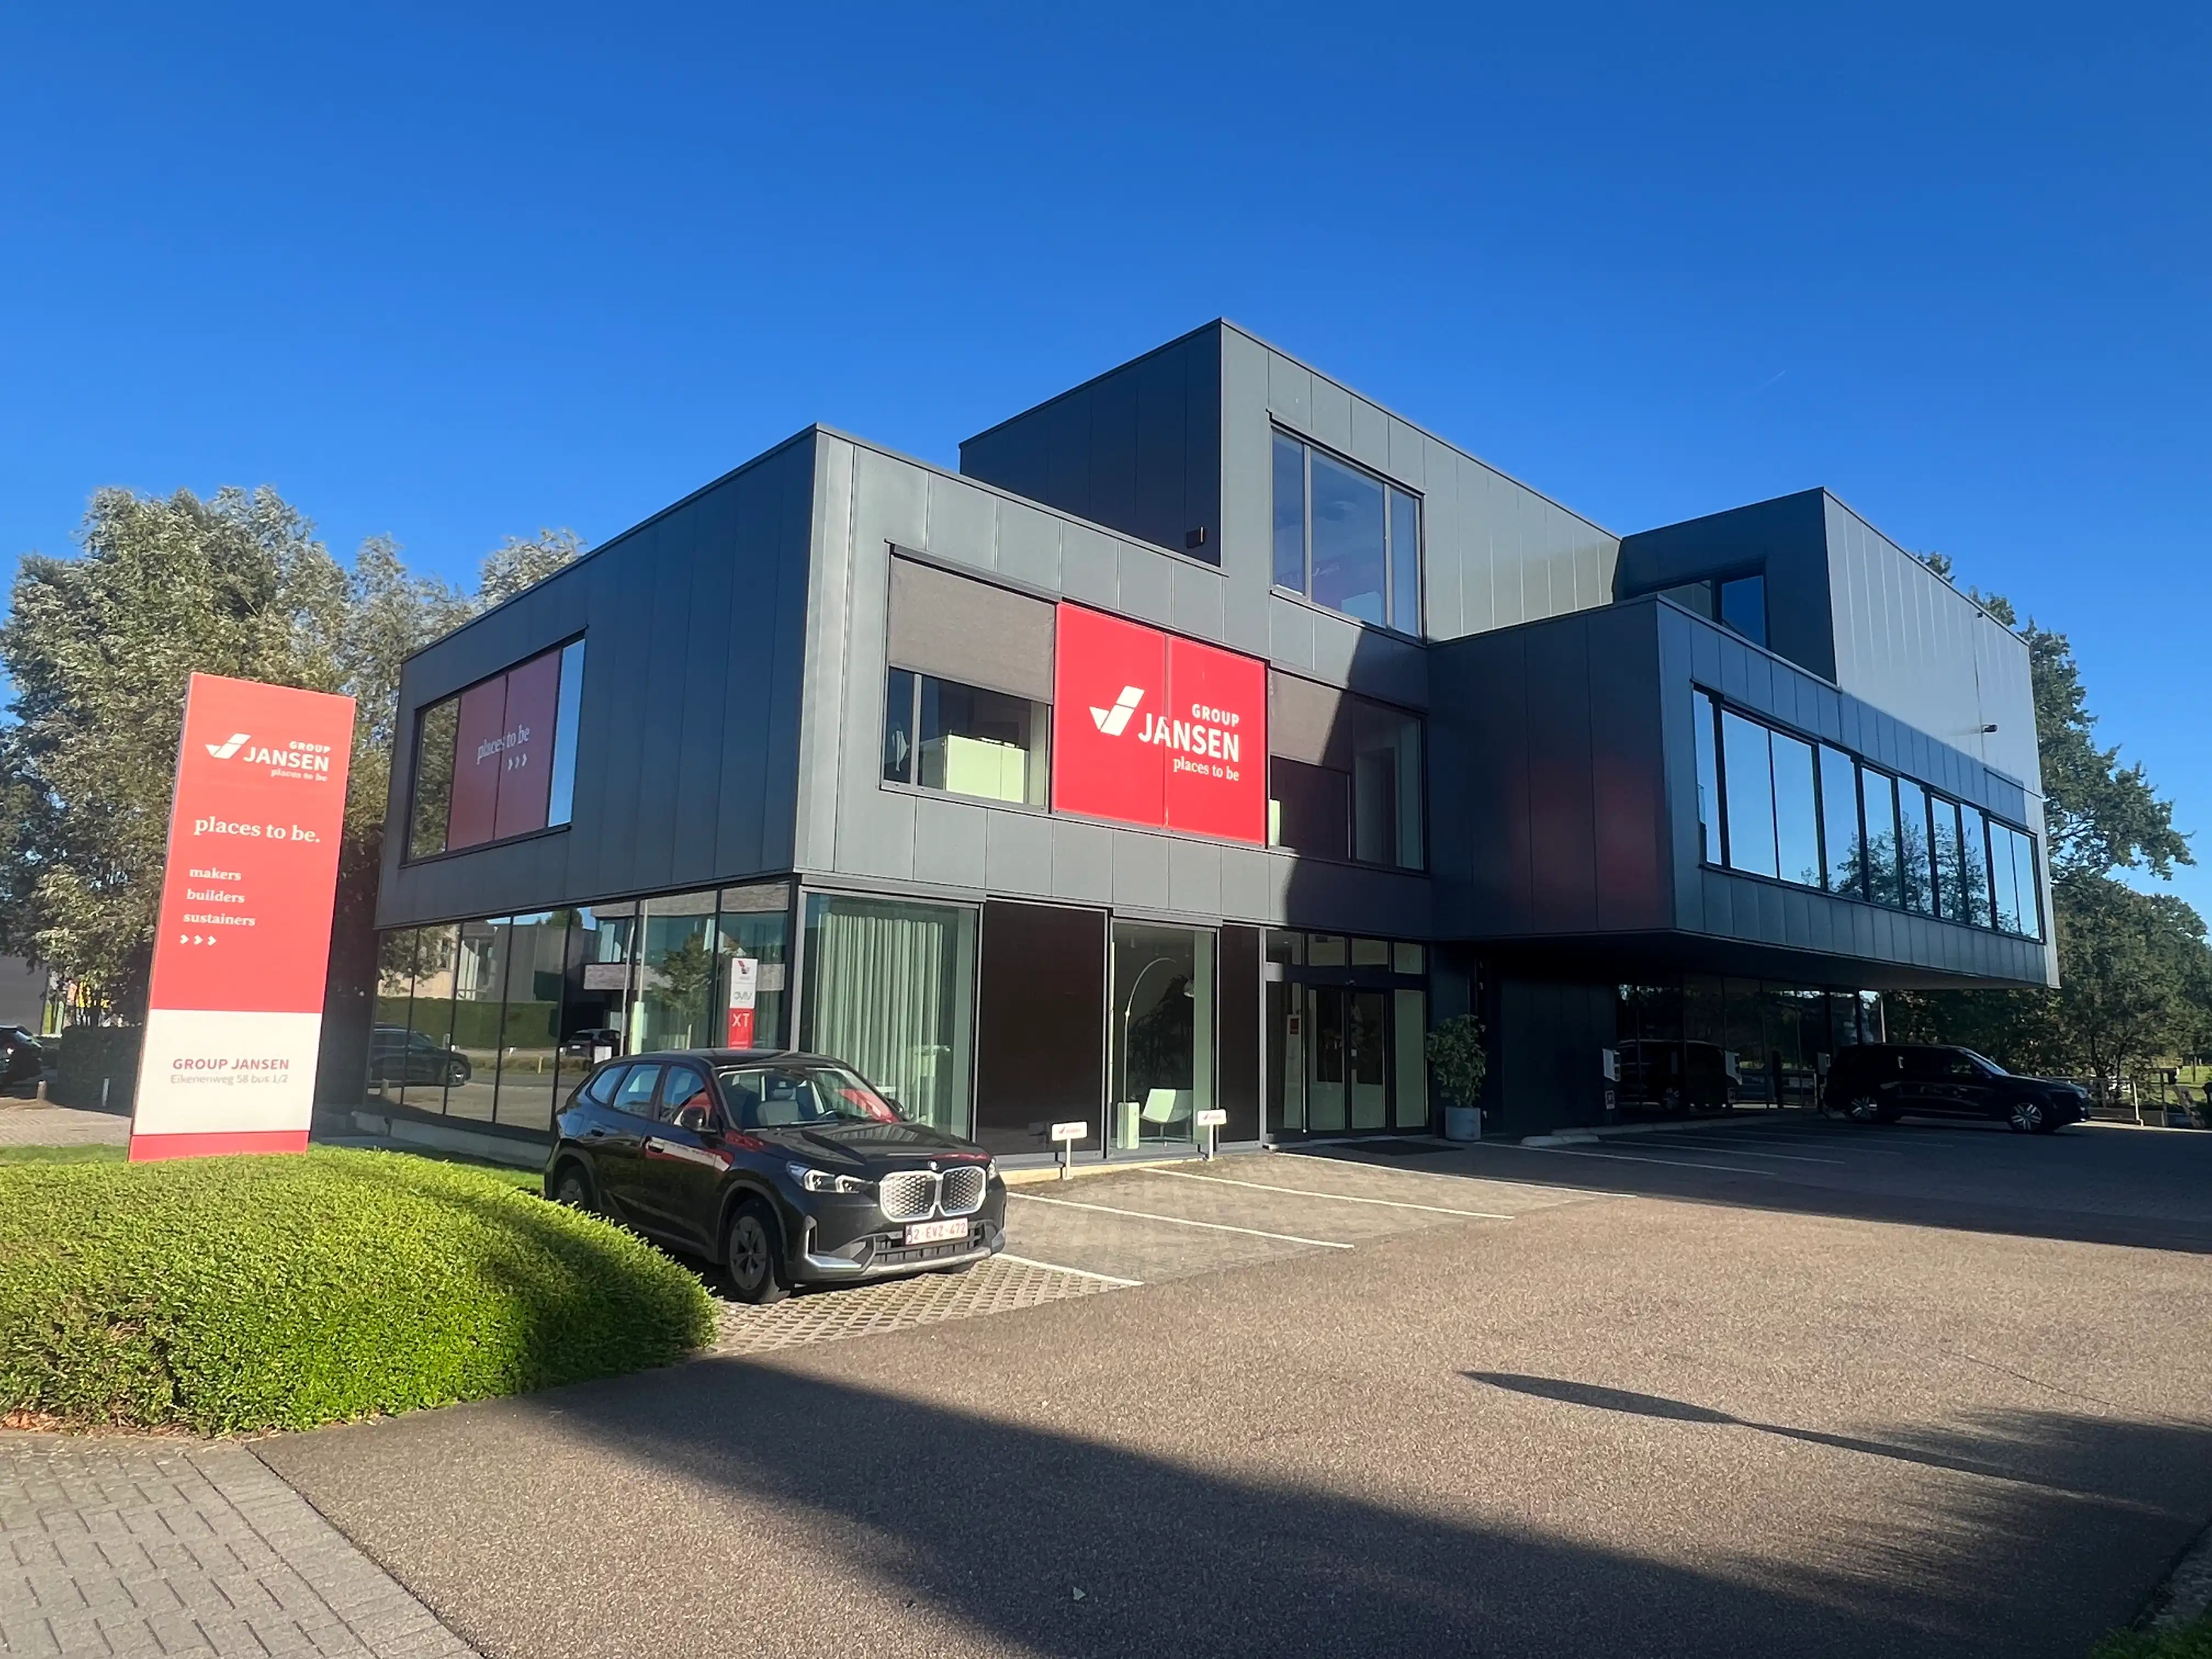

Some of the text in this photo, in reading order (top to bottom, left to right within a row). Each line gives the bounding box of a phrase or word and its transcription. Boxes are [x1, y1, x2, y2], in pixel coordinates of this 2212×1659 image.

[1192, 703, 1240, 727] GROUP
[506, 732, 516, 748] to
[518, 724, 530, 744] be
[1138, 713, 1240, 763] JANSEN
[289, 741, 331, 754] GROUP
[243, 746, 329, 772] JANSEN
[1173, 756, 1240, 781] places to be
[194, 816, 320, 843] places to be.
[189, 867, 241, 881] makers
[186, 889, 245, 903] builders
[183, 913, 256, 927] sustainers
[173, 1058, 290, 1070] GROUP JANSEN
[170, 1074, 235, 1086] Eikenenweg
[236, 1074, 249, 1083] 58
